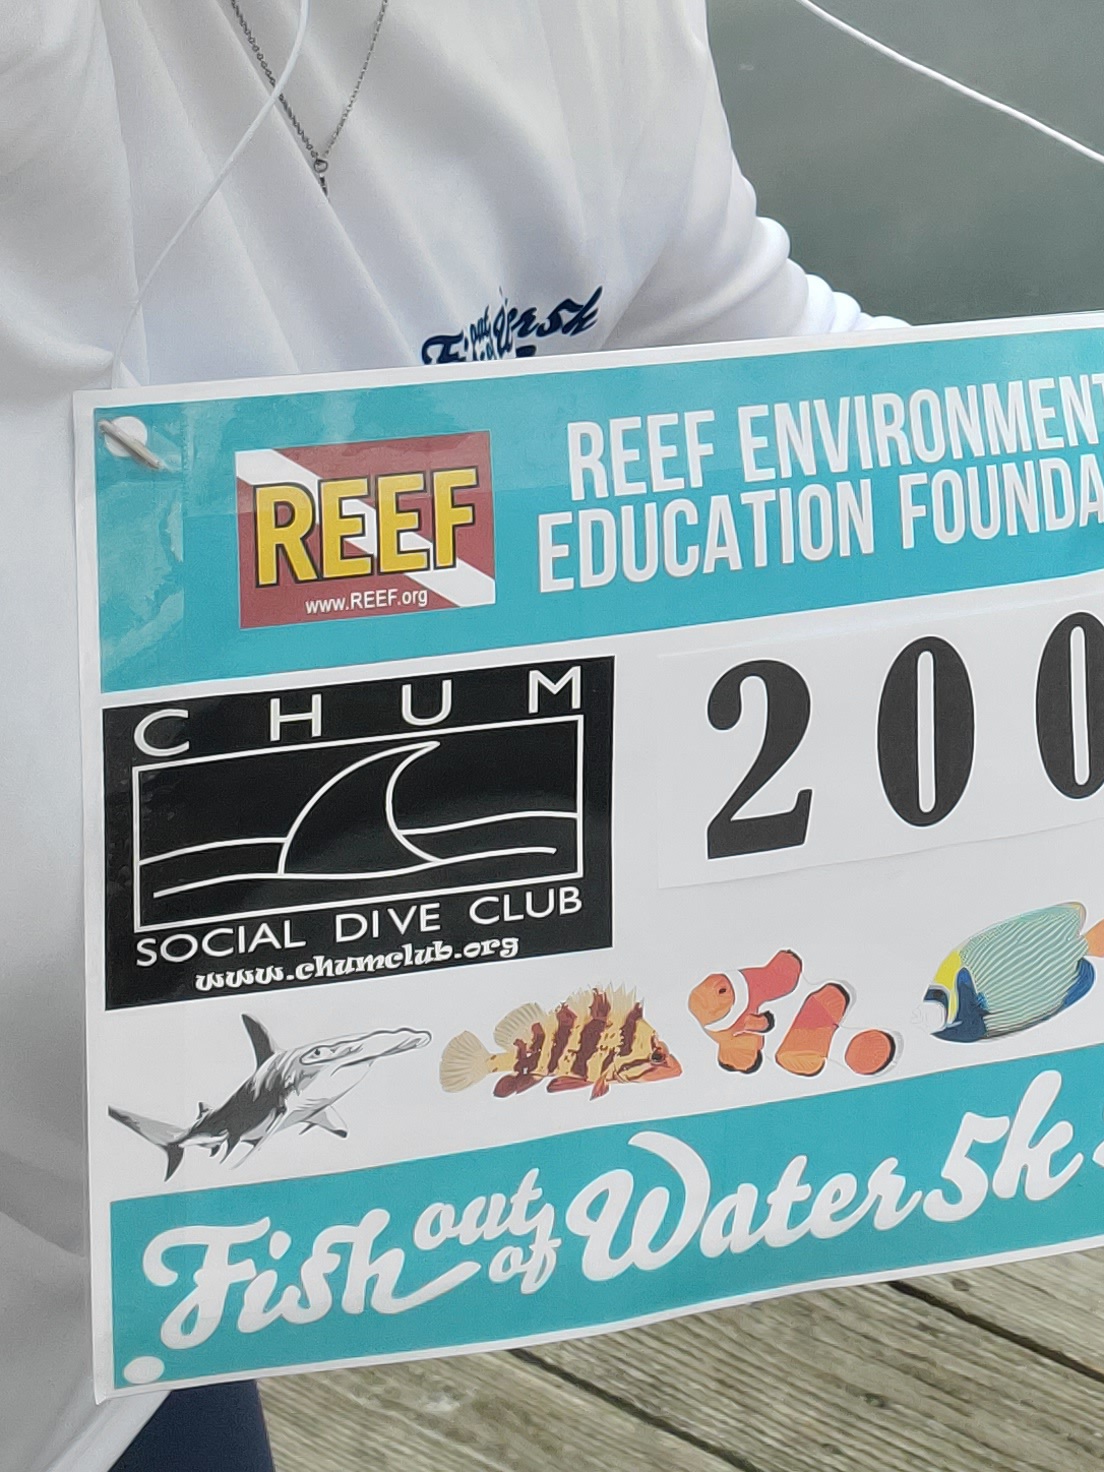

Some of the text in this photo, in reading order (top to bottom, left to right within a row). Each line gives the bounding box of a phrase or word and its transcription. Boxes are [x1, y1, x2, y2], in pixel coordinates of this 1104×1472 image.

[567, 410, 715, 501] REEF
[255, 466, 478, 588] REEF
[538, 478, 875, 593] EDUCATION
[305, 589, 428, 614] www.REEF.org
[134, 666, 583, 758] CHUM
[136, 886, 583, 967] SOCIAL DIVE CLUB
[195, 935, 519, 991] www.chumclub.org
[143, 1208, 481, 1349] Fish
[413, 1168, 543, 1250] out
[489, 1203, 560, 1294] of
[566, 1131, 923, 1282] Water
[923, 1070, 1084, 1221] 5k
